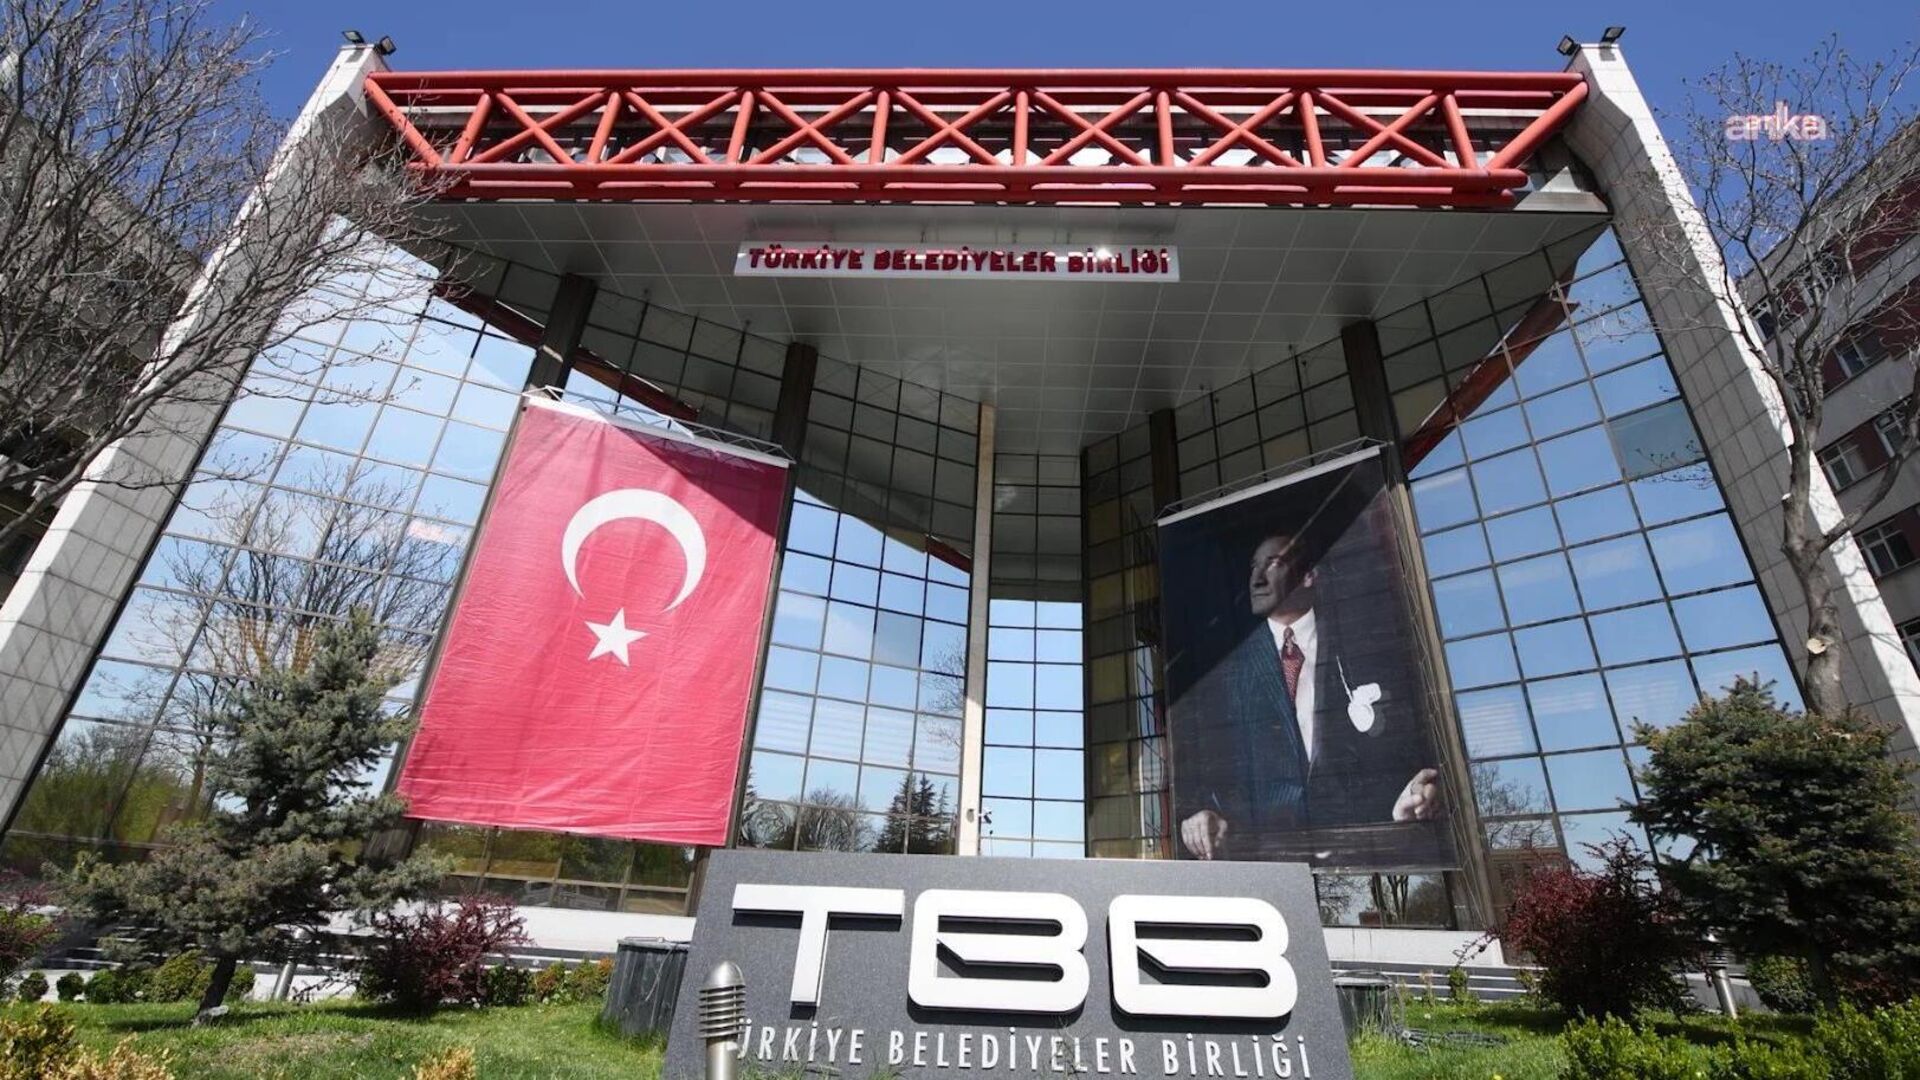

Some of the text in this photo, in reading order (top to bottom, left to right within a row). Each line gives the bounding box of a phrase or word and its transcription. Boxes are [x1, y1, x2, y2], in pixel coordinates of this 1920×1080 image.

[749, 244, 864, 269] TÜRKİYE
[873, 246, 1056, 272] BELEDİYELER
[732, 883, 1298, 1018] TBB
[737, 1018, 1311, 1079] ÜRKİYE BELEDİYELER BİRLİĞİ
